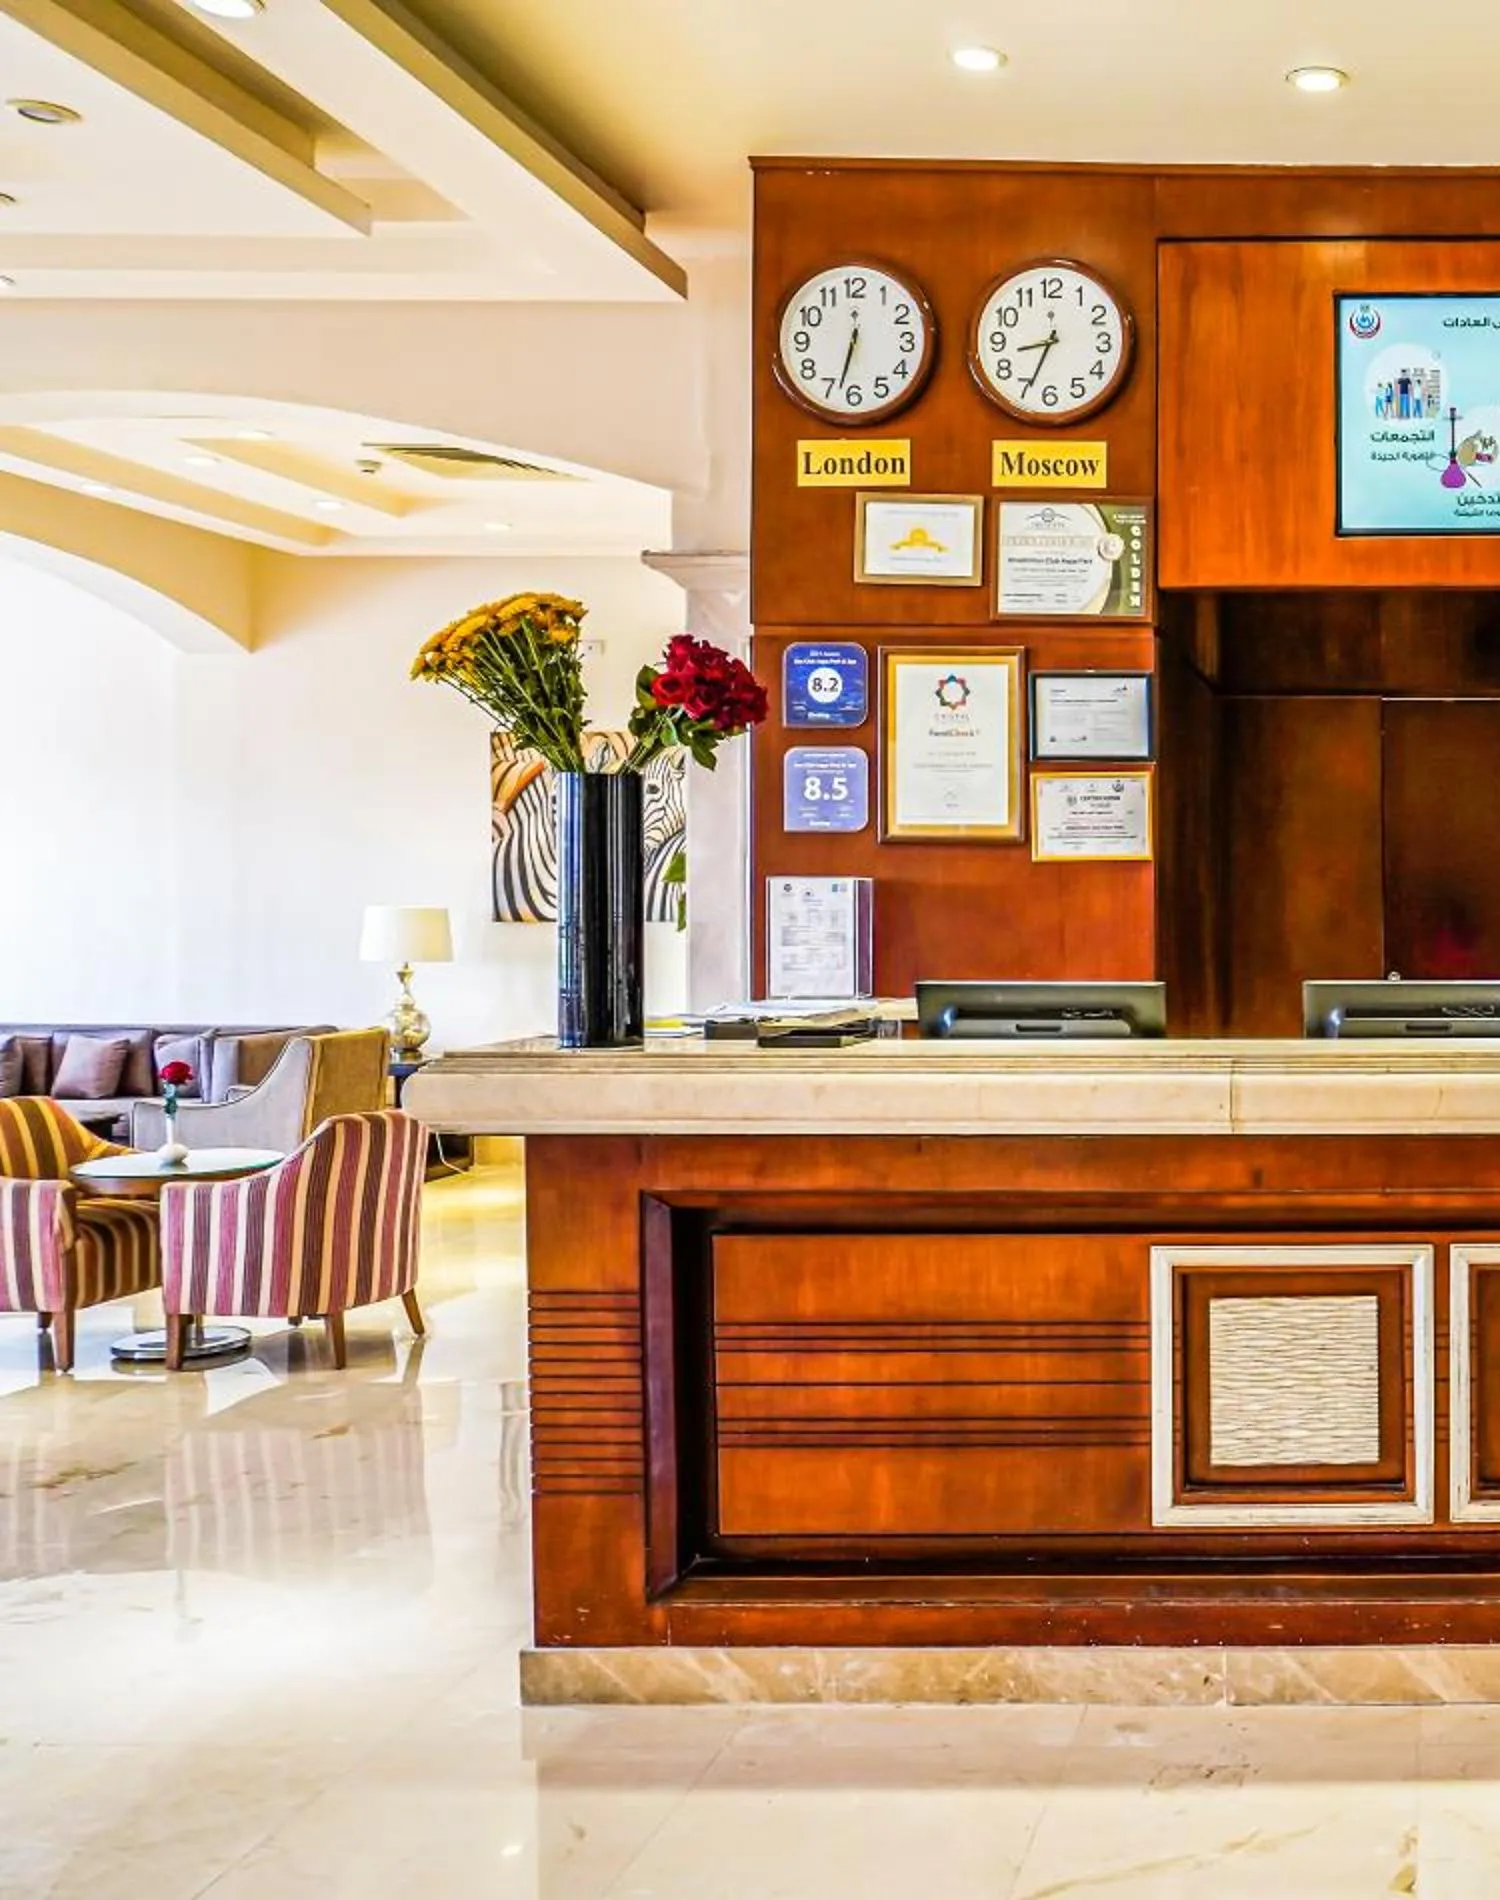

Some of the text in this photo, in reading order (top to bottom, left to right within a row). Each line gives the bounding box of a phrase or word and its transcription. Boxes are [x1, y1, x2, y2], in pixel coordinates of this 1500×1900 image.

[819, 288, 836, 308] 11
[844, 278, 866, 298] 12
[879, 286, 887, 304] 1
[1015, 288, 1032, 308] 11
[1041, 278, 1062, 298] 12
[1076, 286, 1083, 306] 1
[800, 306, 822, 327] 10
[894, 304, 909, 324] 2
[996, 307, 1019, 327] 10
[1092, 305, 1106, 325] 2
[1443, 316, 1491, 327] العادات
[794, 331, 810, 352] 9
[900, 332, 914, 352] 3
[990, 332, 1006, 352] 9
[1096, 332, 1112, 353] 3
[801, 359, 816, 380] 8
[893, 360, 908, 379] 4
[996, 359, 1012, 380] 8
[1090, 360, 1104, 380] 4
[822, 378, 836, 398] 7
[846, 385, 862, 406] 6
[874, 377, 889, 398] 5
[1018, 379, 1031, 399] 7
[1042, 386, 1058, 406] 6
[1070, 378, 1085, 398] 5
[1370, 429, 1435, 445] التجمعات
[803, 450, 906, 477] London
[1000, 451, 1099, 477] Moscow
[812, 677, 839, 692] 8.2
[804, 776, 849, 801] 8.5
